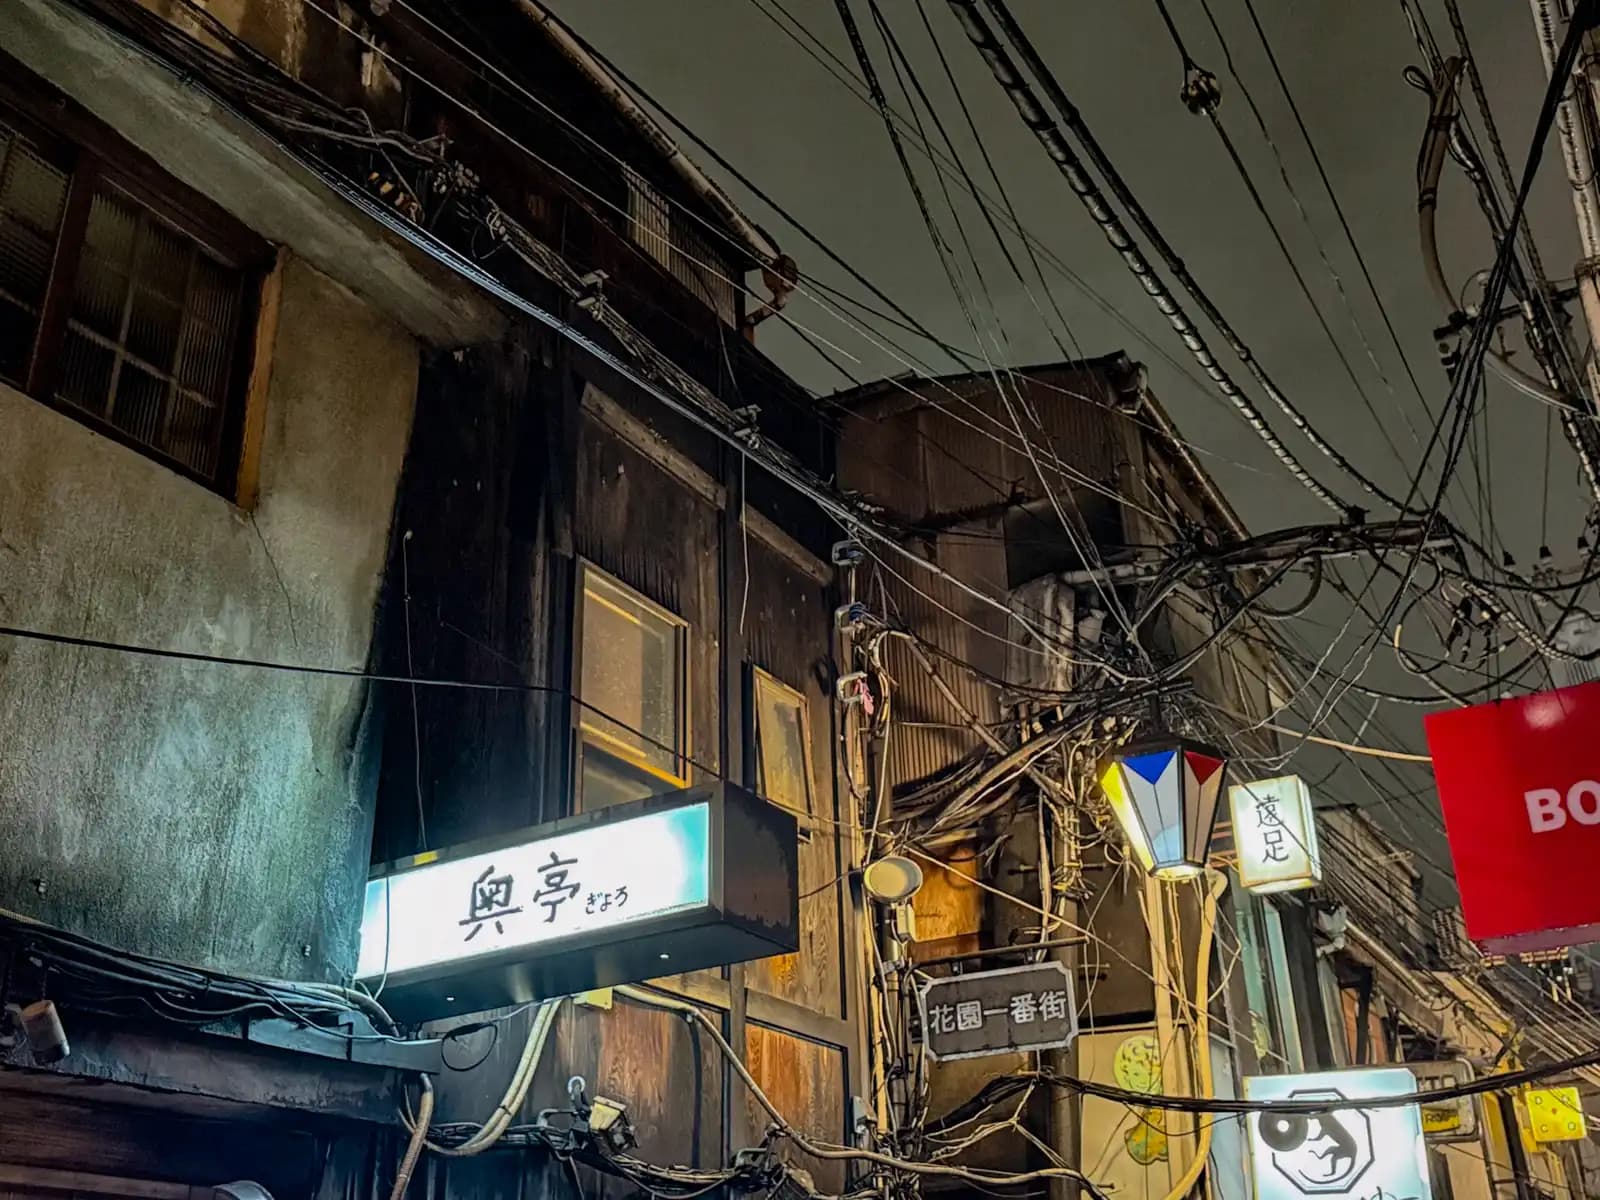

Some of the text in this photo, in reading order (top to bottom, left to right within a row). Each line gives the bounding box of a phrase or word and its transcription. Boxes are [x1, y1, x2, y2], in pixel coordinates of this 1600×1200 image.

[1256, 794, 1289, 863] 遠足
[1524, 780, 1600, 833] BO
[929, 990, 1067, 1034] 花園一番街
